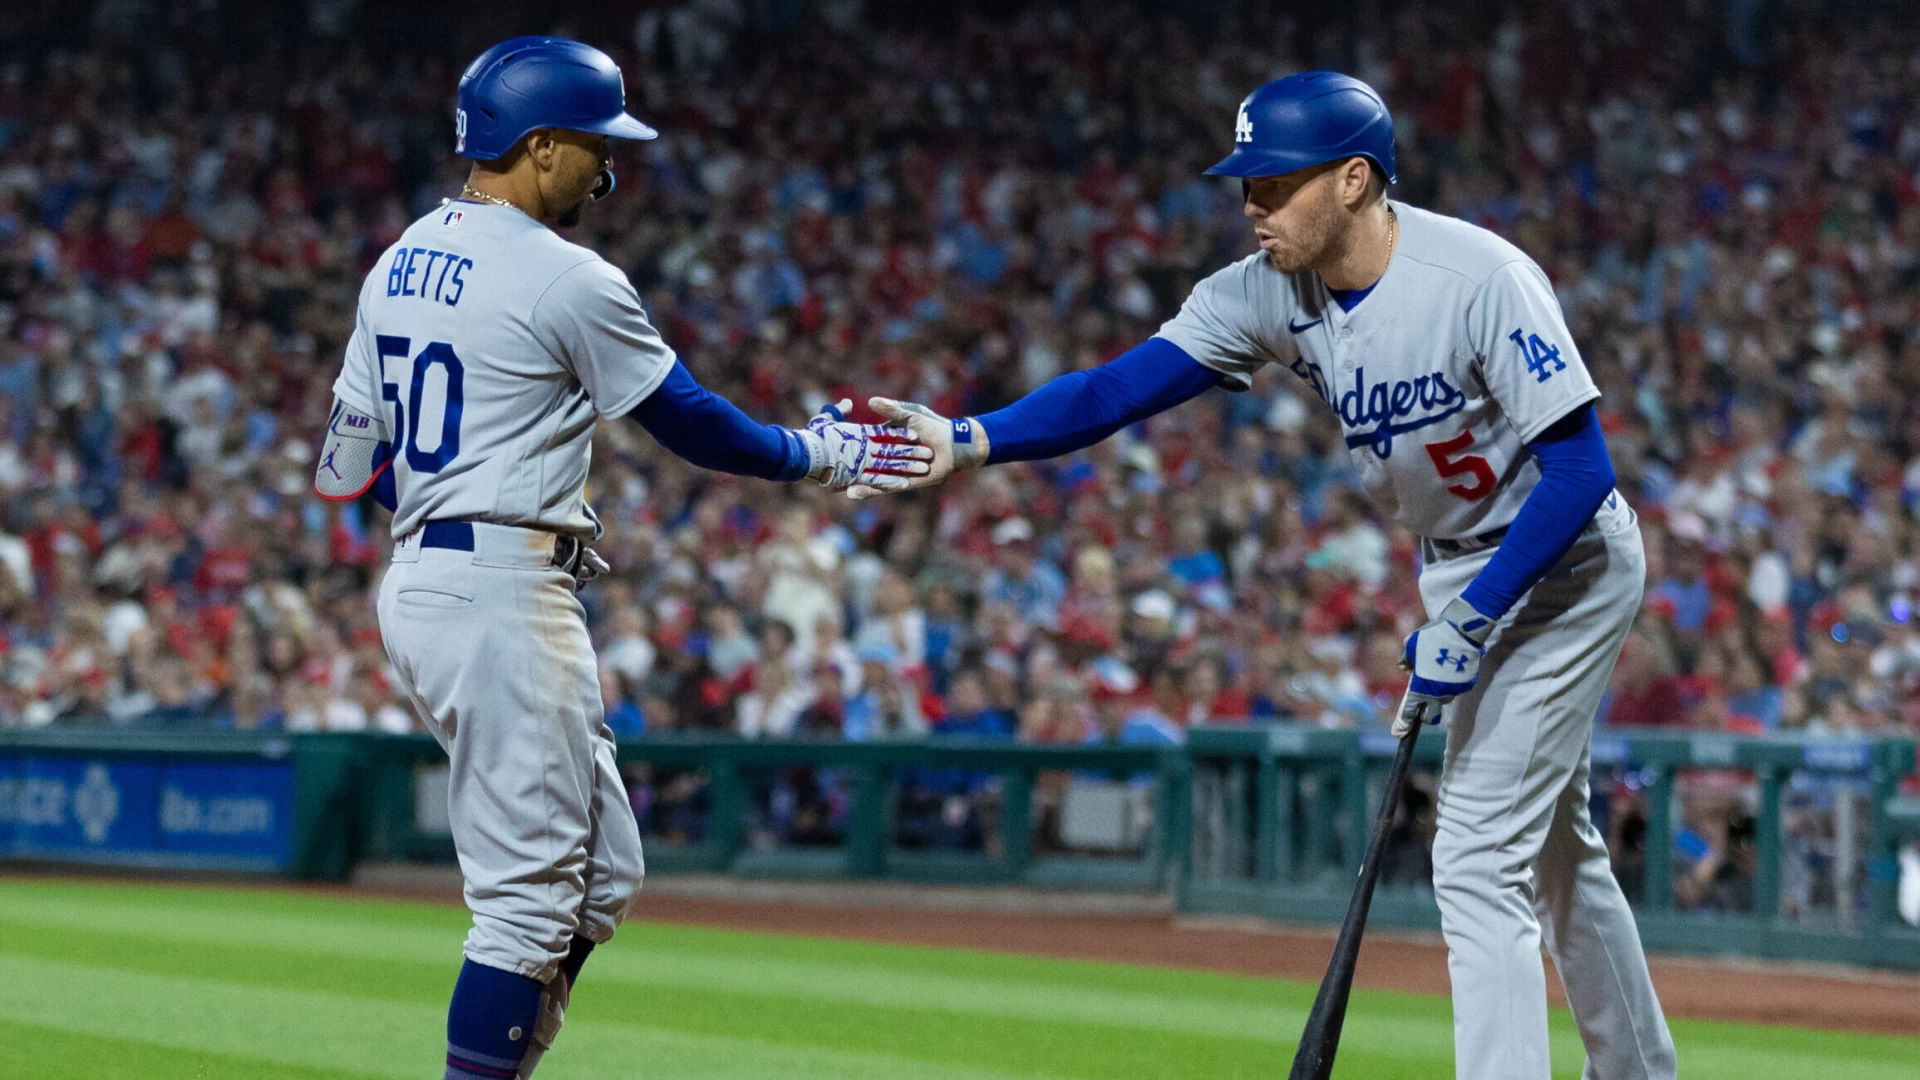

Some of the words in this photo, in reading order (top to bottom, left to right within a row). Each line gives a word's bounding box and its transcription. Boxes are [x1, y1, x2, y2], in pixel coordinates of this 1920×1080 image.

[386, 247, 474, 307] BETTS
[1508, 327, 1567, 384] LA
[344, 413, 370, 429] MB
[375, 334, 465, 475] 50
[955, 421, 969, 433] 5
[1290, 356, 1466, 460] Ddgers
[1424, 428, 1498, 503] 5
